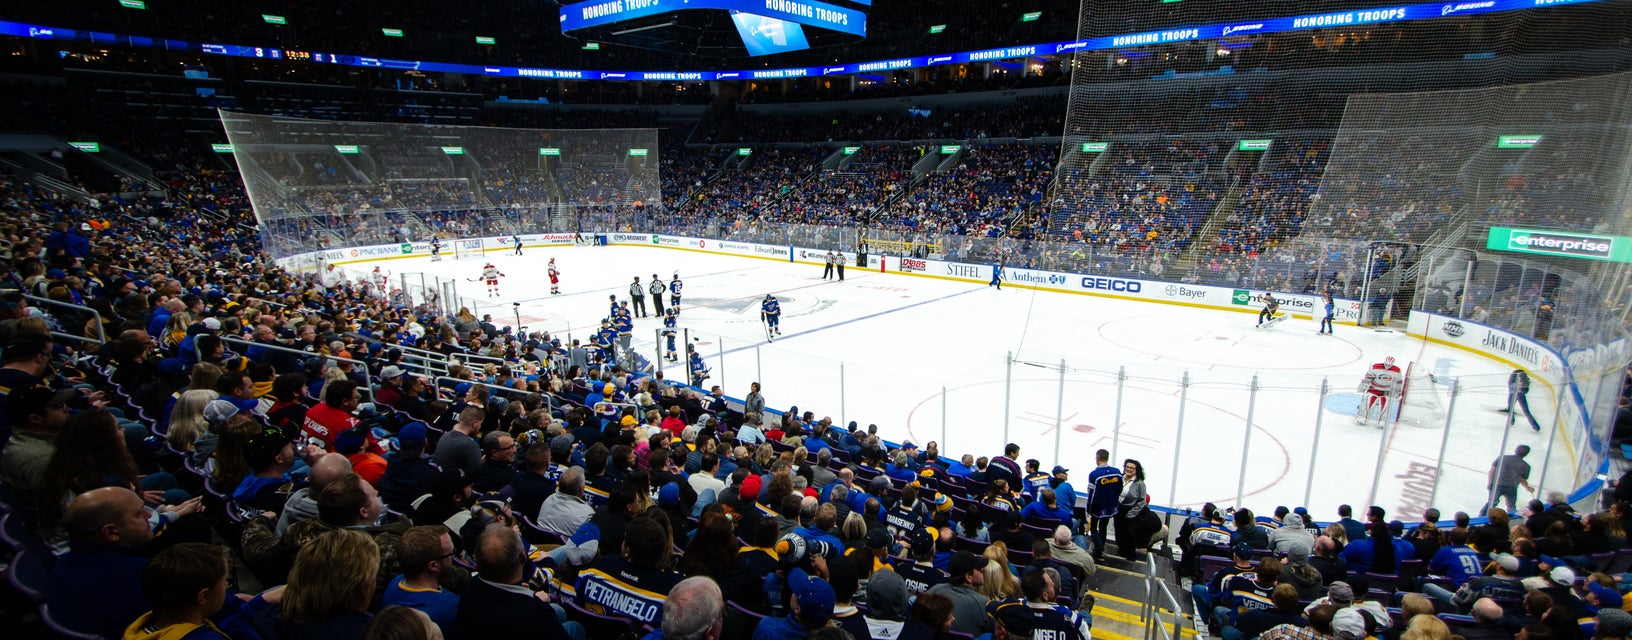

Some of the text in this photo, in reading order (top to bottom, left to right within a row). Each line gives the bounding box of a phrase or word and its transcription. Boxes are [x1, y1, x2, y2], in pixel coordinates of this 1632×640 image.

[583, 0, 623, 20] HONORING
[1455, 1, 1495, 10] BOEING
[765, 0, 848, 26] HONORING TROOPS
[1293, 9, 1405, 28] HONORING TROOPS
[1232, 23, 1263, 31] BOEING
[1113, 29, 1199, 46] HONORING TROOPS
[255, 47, 263, 57] 3
[285, 50, 310, 59] 12:38
[330, 54, 337, 63] 1
[970, 46, 1036, 61] HONORING TROOPS
[858, 59, 912, 71] HONORING TROOPS
[518, 69, 582, 78] HONORING TROOPS
[678, 72, 702, 80] TROOPS
[754, 68, 807, 78] HONORING TROOPS
[1514, 235, 1610, 252] enterprise
[947, 263, 982, 279] STIFEL
[1011, 271, 1048, 284] Anthem
[1081, 277, 1142, 293] GEICO
[1179, 287, 1207, 298] Bayer
[886, 513, 915, 531] TARASENKO
[1458, 555, 1482, 574] 91
[905, 578, 929, 592] OSHIE
[584, 579, 658, 622] PIETRANGELO
